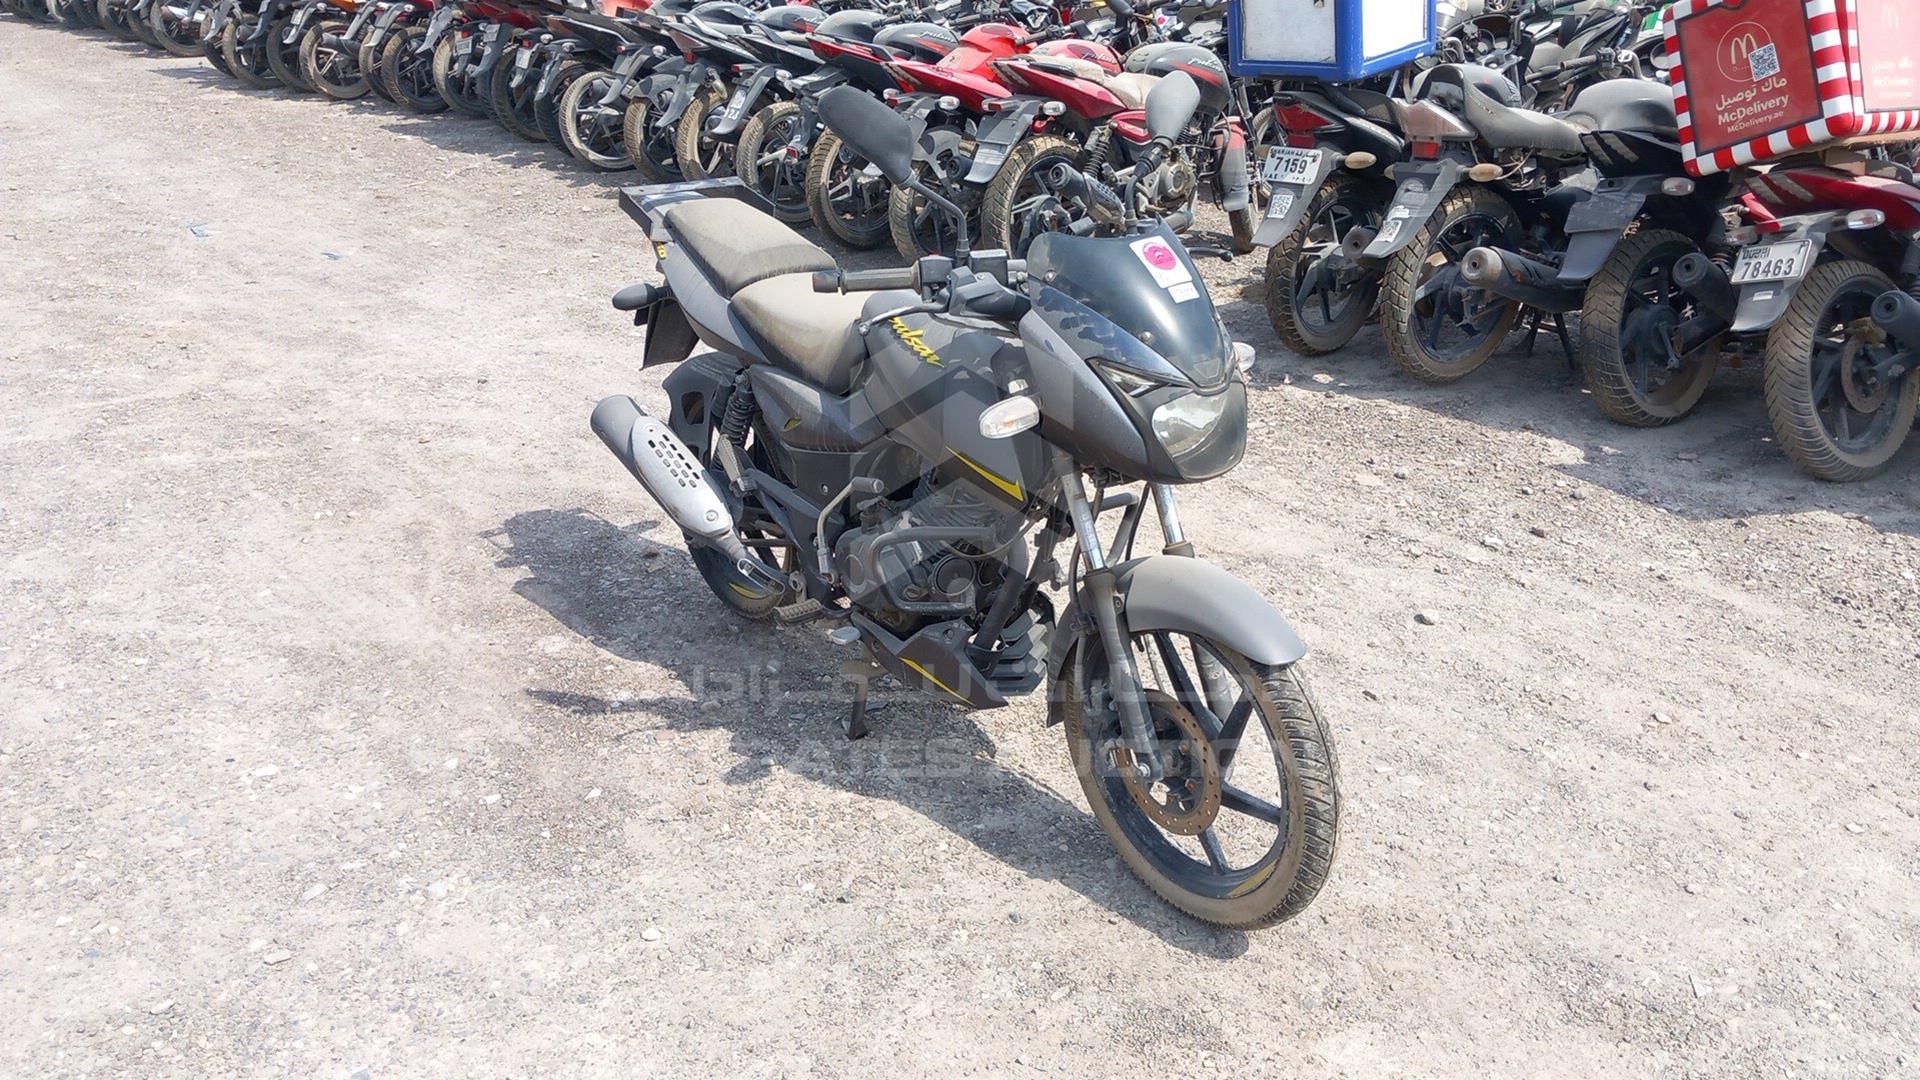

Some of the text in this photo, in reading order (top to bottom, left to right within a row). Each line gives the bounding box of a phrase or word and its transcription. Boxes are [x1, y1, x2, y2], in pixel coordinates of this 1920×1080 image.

[1715, 77, 1788, 111] ماك توصيل
[1717, 95, 1790, 126] McDelivery
[1727, 111, 1784, 133] McDelivery.ae
[1274, 156, 1308, 174] 7159
[1741, 257, 1795, 280] 78463
